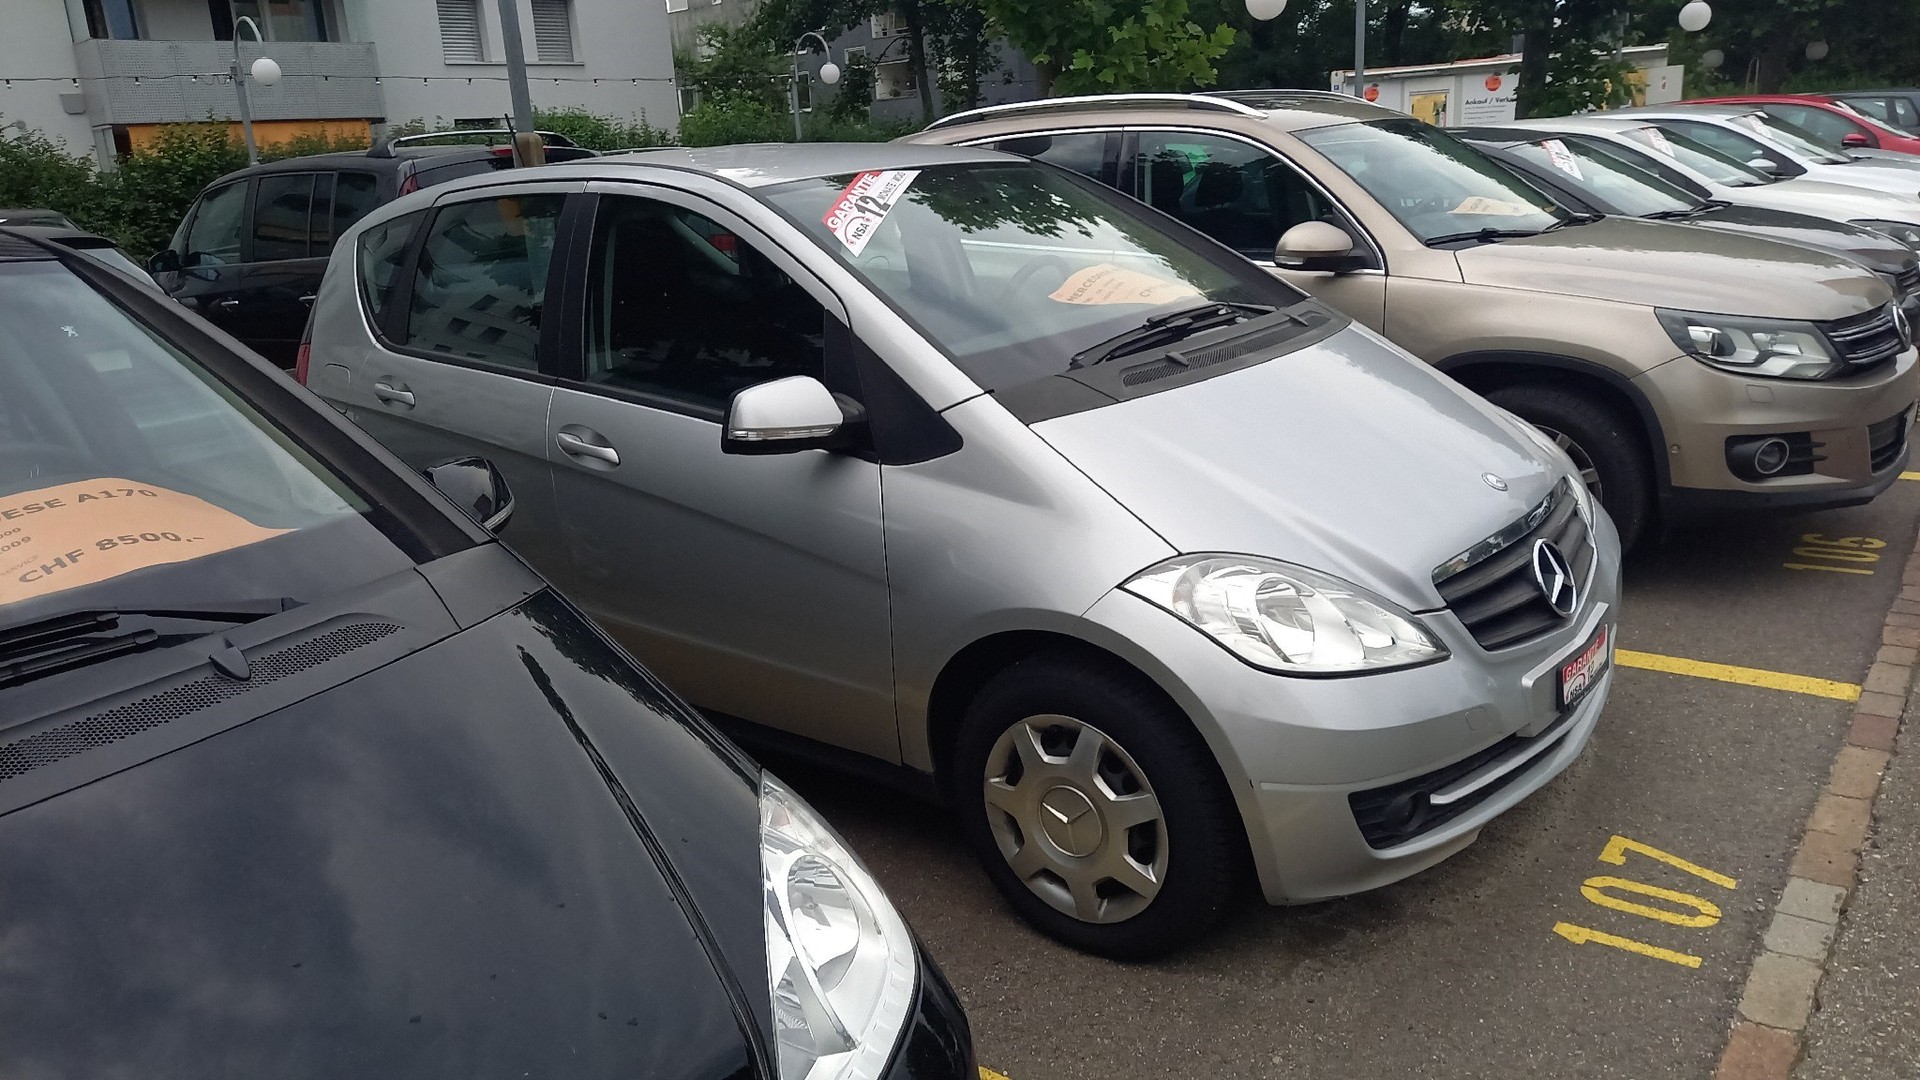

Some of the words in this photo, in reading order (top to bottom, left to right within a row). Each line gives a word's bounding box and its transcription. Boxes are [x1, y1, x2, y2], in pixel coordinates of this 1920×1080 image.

[1465, 97, 1488, 105] Ankauf
[827, 173, 877, 229] GARANTIE
[854, 195, 891, 218] 12
[851, 222, 870, 240] NSA
[0, 498, 67, 523] ESE
[77, 488, 159, 504] A170
[0, 536, 32, 554] 009
[1782, 533, 1887, 576] 106
[18, 549, 85, 583] CHF
[1552, 834, 1739, 969] 107
